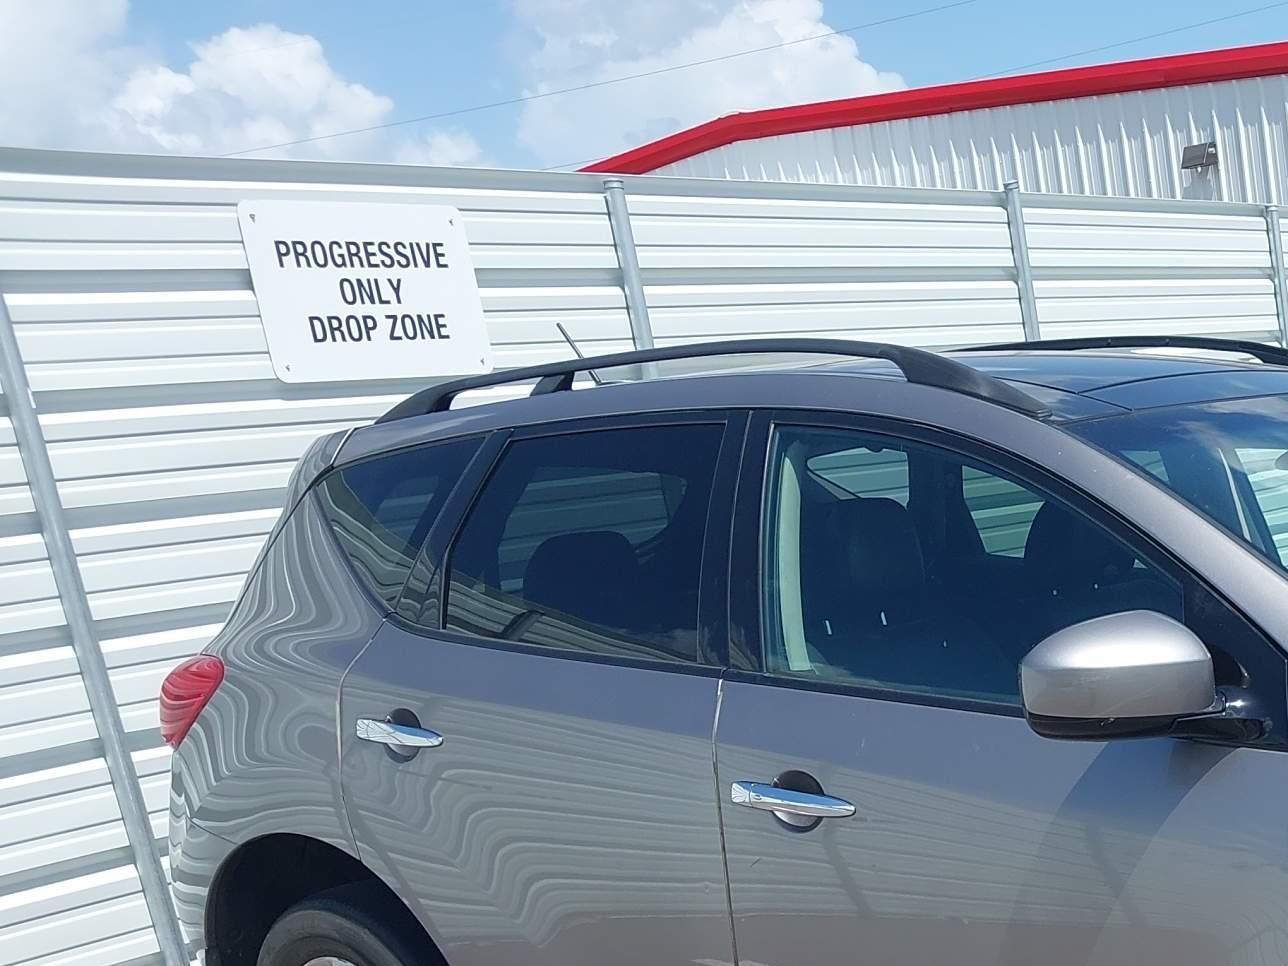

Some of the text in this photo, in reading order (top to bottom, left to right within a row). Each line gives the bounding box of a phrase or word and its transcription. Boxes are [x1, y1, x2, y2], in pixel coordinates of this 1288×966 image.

[273, 239, 449, 269] PROGRESSIVE
[339, 277, 403, 305] ONLY
[308, 313, 450, 343] DROP ZONE
